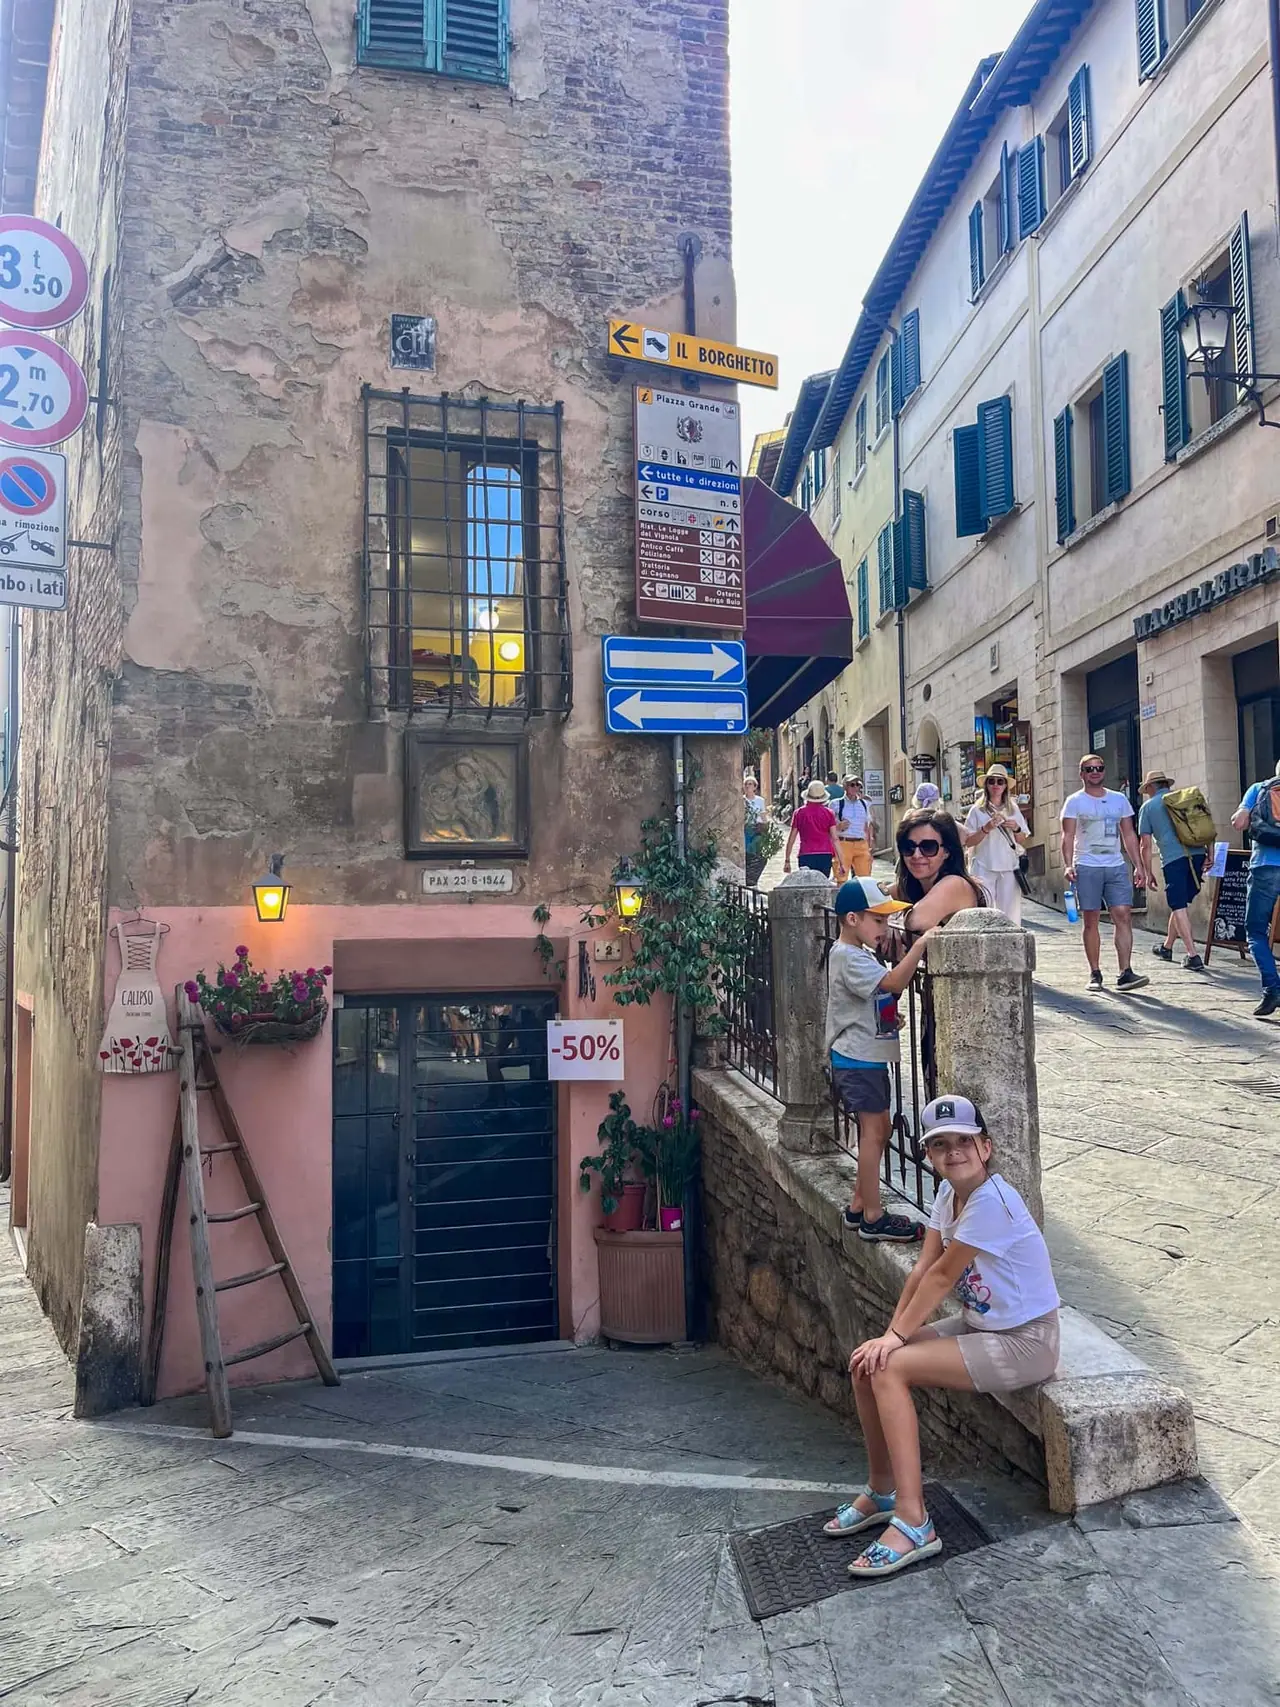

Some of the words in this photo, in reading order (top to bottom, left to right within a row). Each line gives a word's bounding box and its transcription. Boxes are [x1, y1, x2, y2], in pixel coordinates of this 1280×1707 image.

[676, 341, 688, 360] IL
[698, 346, 774, 377] BORGHETTO
[29, 366, 47, 381] m
[656, 393, 685, 407] Piazza
[688, 400, 720, 414] Grande
[656, 470, 681, 482] tutte
[685, 474, 695, 484] le
[699, 477, 739, 491] direzioni
[732, 500, 738, 508] 6
[640, 507, 670, 518] corso
[15, 520, 60, 533] rimozione
[640, 522, 657, 531] Rist.
[669, 526, 689, 536] Logge
[654, 532, 679, 541] Vignola
[640, 541, 663, 551] Antico
[665, 544, 684, 553] Caffè
[640, 549, 672, 559] Poliziano
[641, 561, 670, 571] Trattoria
[650, 569, 679, 580] Cagnano
[37, 578, 63, 597] lati
[1133, 546, 1280, 640] MACELLERIA
[716, 589, 741, 599] Osteria
[429, 876, 449, 886] PAX
[605, 945, 613, 956] 2
[121, 990, 154, 1006] CALIPSO
[551, 1034, 620, 1061] -50%
